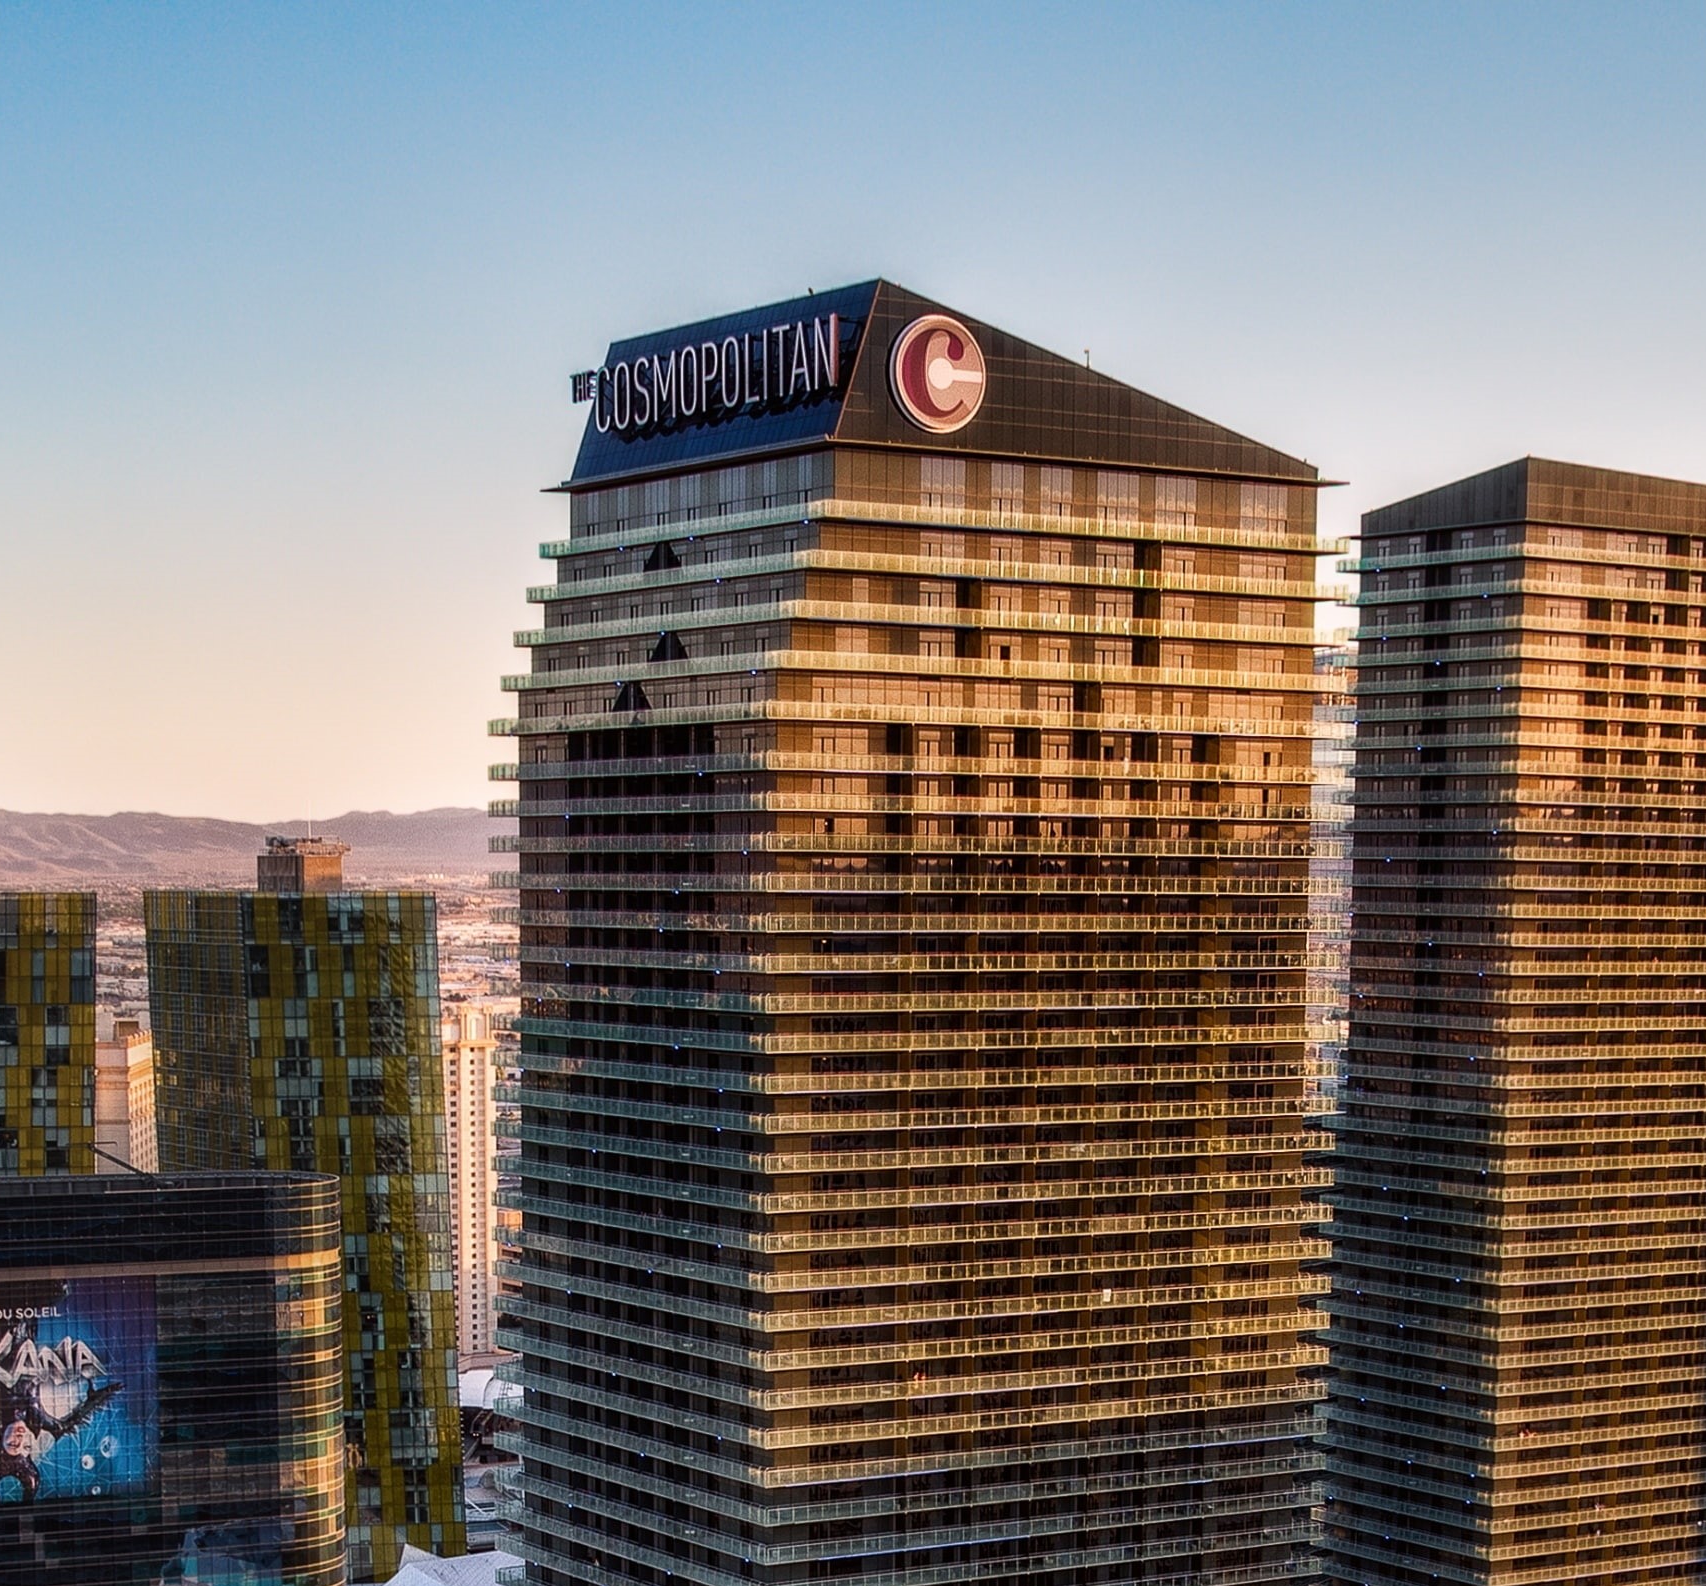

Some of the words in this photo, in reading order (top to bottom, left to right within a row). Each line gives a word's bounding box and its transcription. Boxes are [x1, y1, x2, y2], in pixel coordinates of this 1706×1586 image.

[569, 369, 597, 404] THE
[596, 313, 838, 434] COSMOPOLITAN
[15, 1305, 62, 1320] SOLEIL
